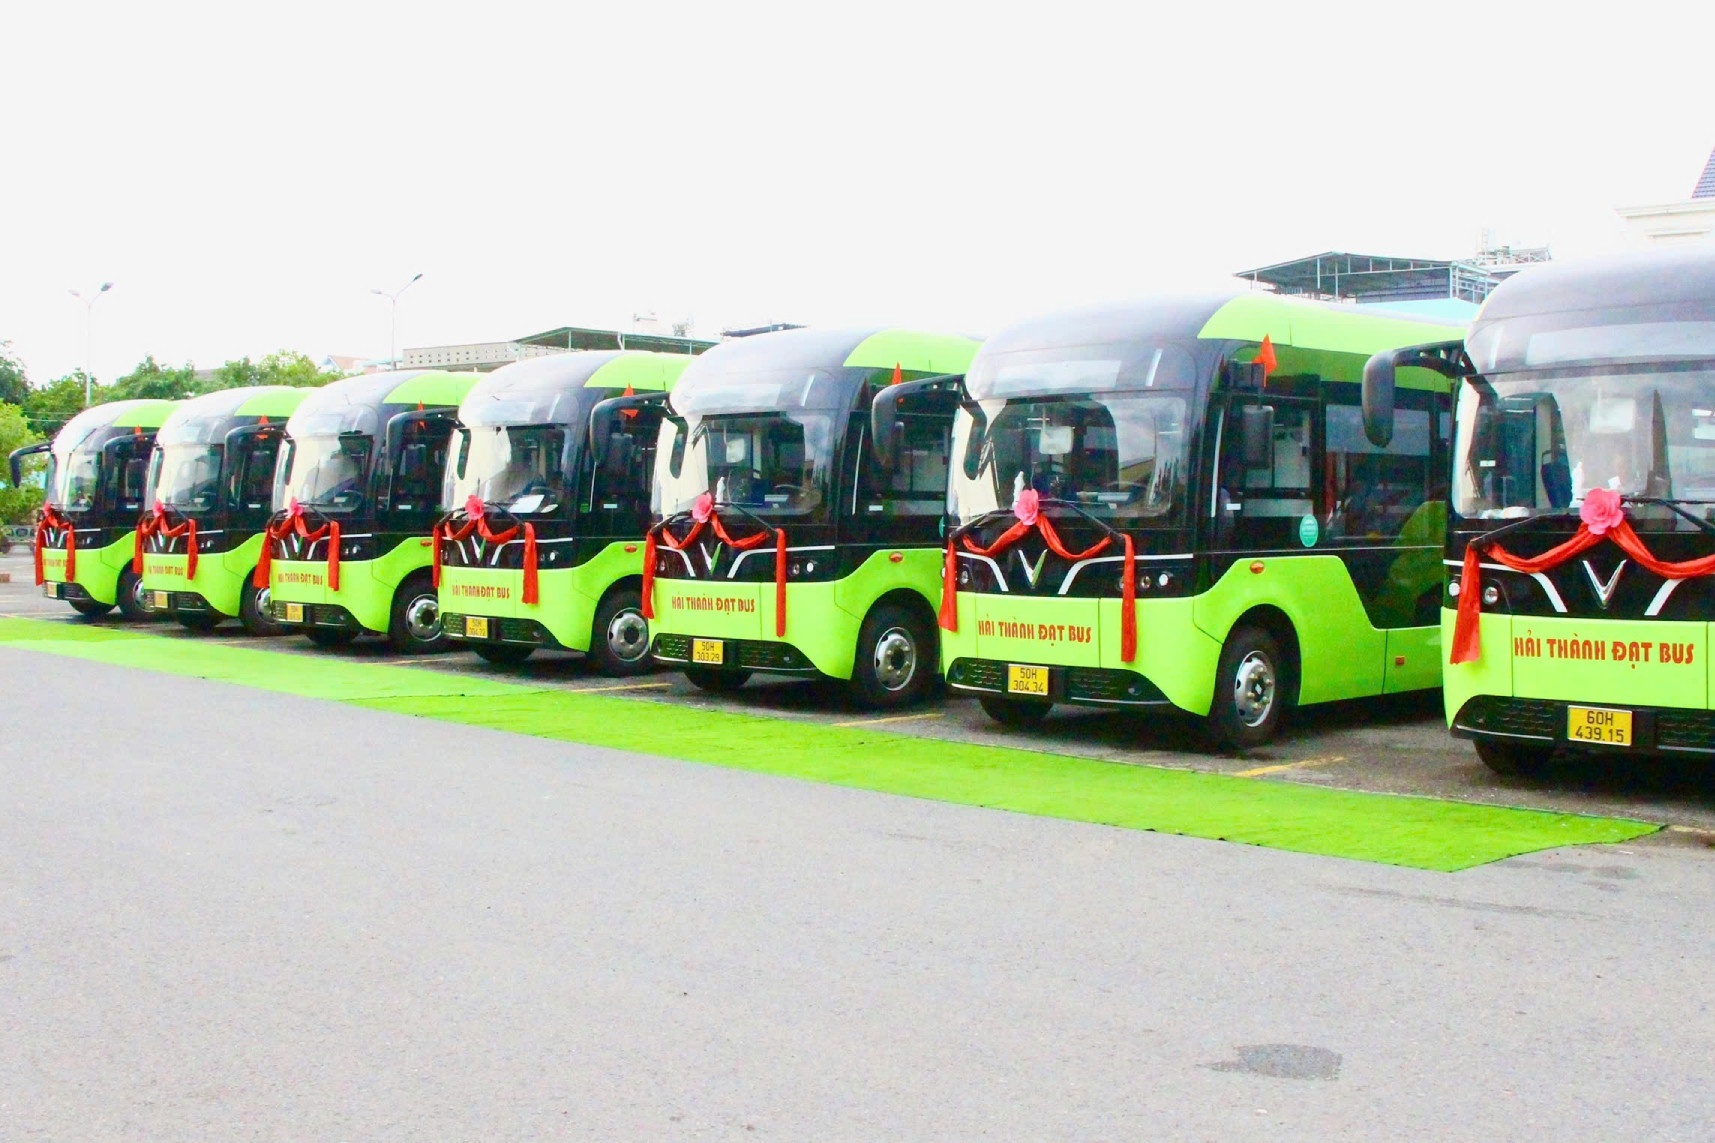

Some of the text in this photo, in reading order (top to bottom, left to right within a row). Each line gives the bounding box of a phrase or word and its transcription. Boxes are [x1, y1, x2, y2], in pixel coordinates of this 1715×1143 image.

[496, 586, 510, 599] BUS
[716, 597, 736, 616] ĐẠT
[738, 598, 755, 612] BUS
[978, 613, 1092, 646] HẢI THÀNH ĐẠT BUS
[702, 642, 714, 652] 50H
[1514, 630, 1694, 669] HẢI THÀNH ĐẠT BUS
[1020, 668, 1037, 680] 50H
[1013, 680, 1044, 692] 304.34
[1586, 710, 1614, 726] 60H
[1575, 726, 1624, 743] 439.15
